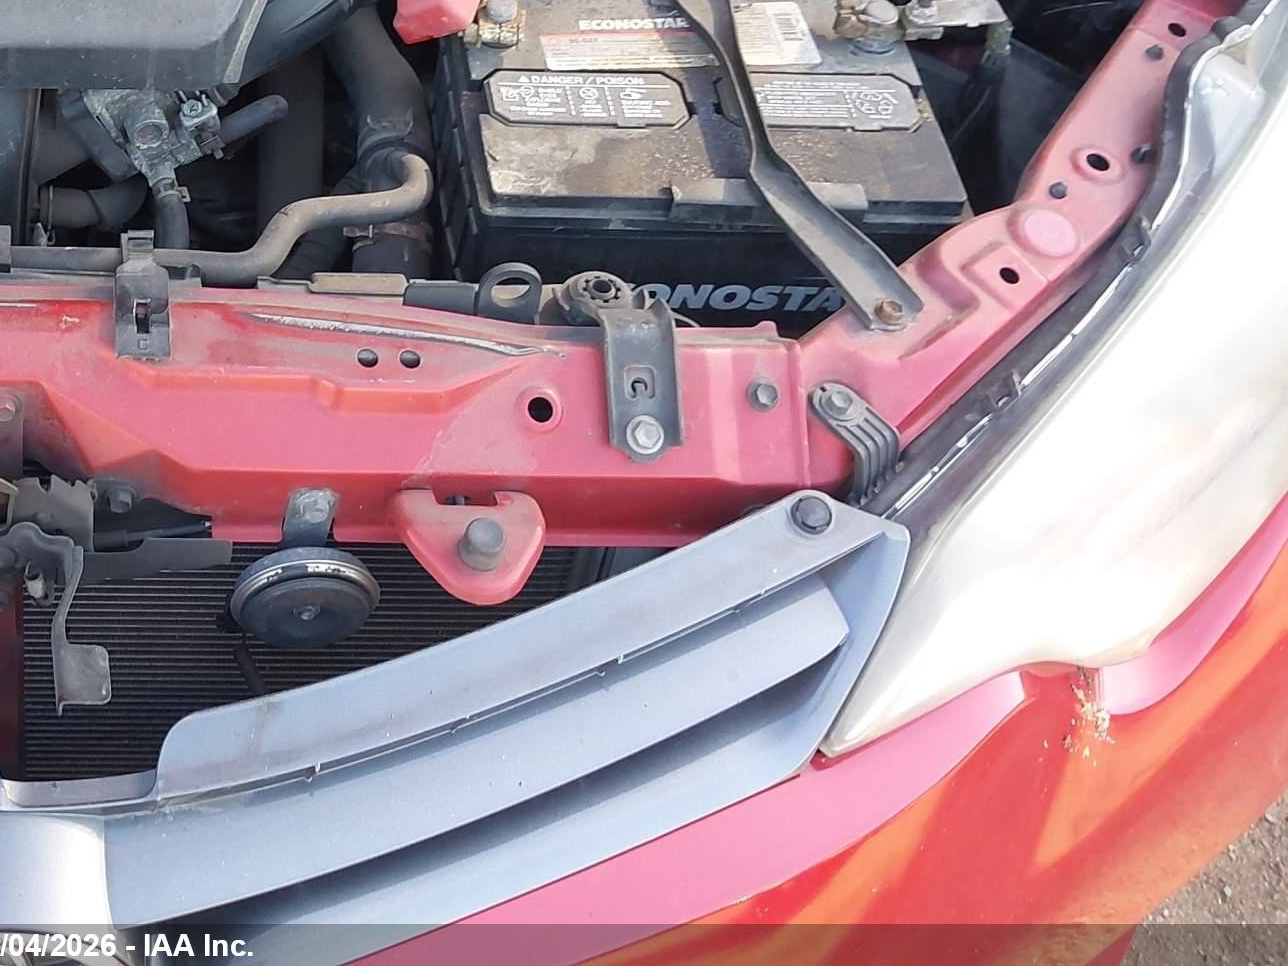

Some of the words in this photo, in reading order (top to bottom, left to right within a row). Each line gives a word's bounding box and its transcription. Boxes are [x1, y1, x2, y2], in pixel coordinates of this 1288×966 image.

[578, 17, 690, 31] ECONOSTAR
[530, 76, 584, 85] DANGER
[595, 77, 644, 85] POISON
